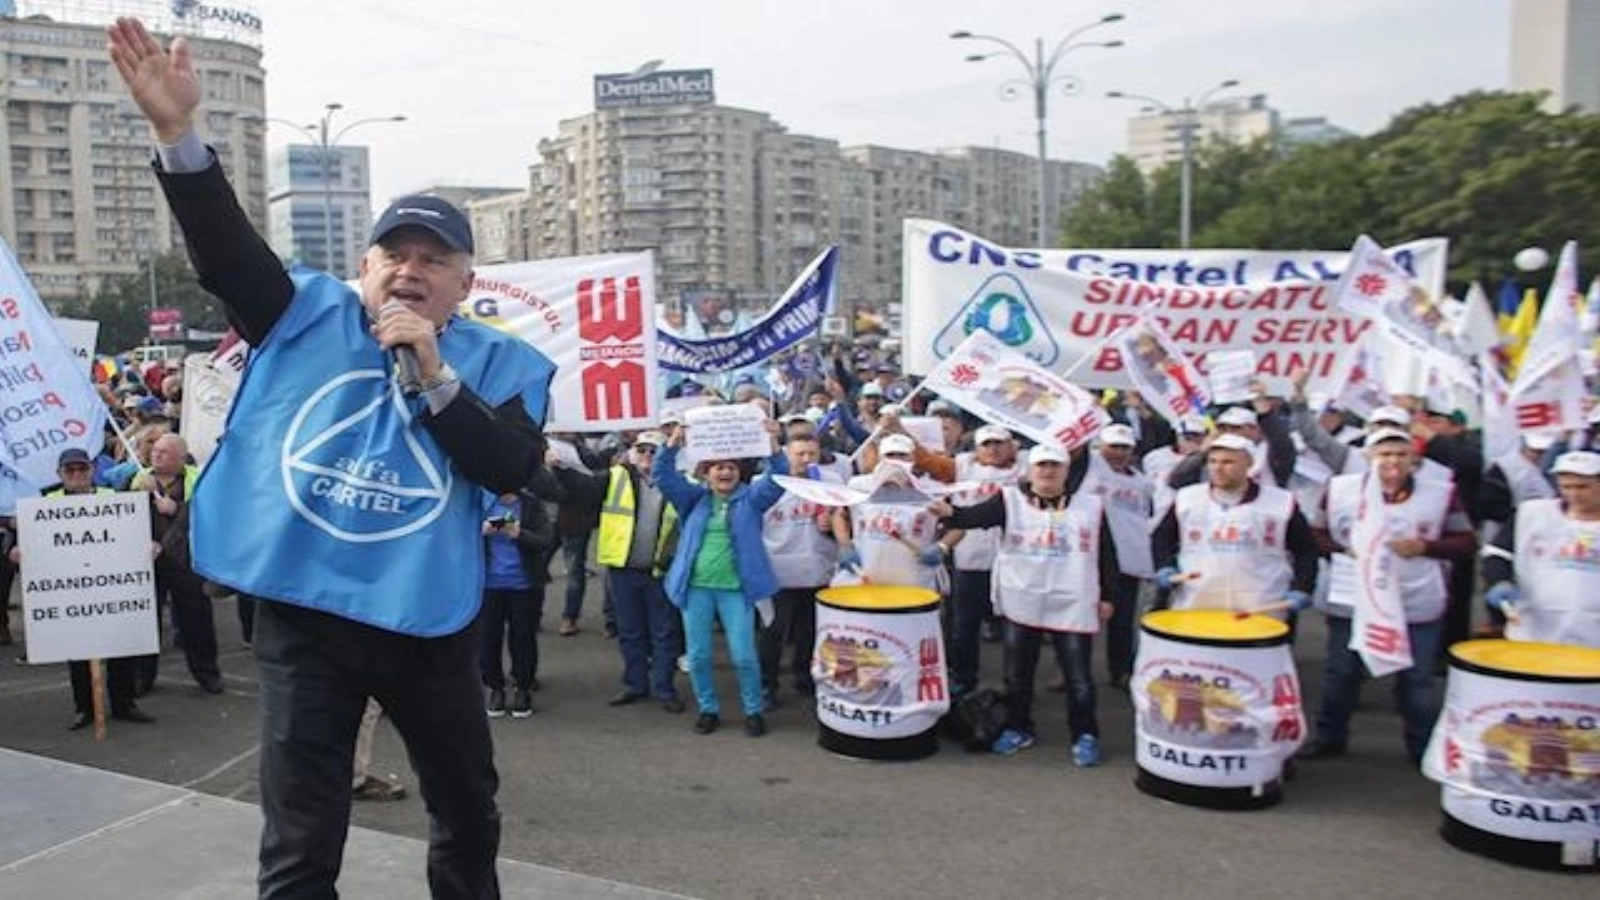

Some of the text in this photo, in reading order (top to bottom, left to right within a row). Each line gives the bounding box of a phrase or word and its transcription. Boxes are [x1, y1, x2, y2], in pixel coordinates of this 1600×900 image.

[598, 73, 710, 98] DentalMed
[1066, 253, 1247, 288] Cartel
[1273, 249, 1417, 281] ALA
[335, 456, 400, 485] alfa
[311, 477, 406, 514] CARTEL
[53, 528, 116, 547] M.A.I.
[32, 599, 151, 621] DE GUVERN!
